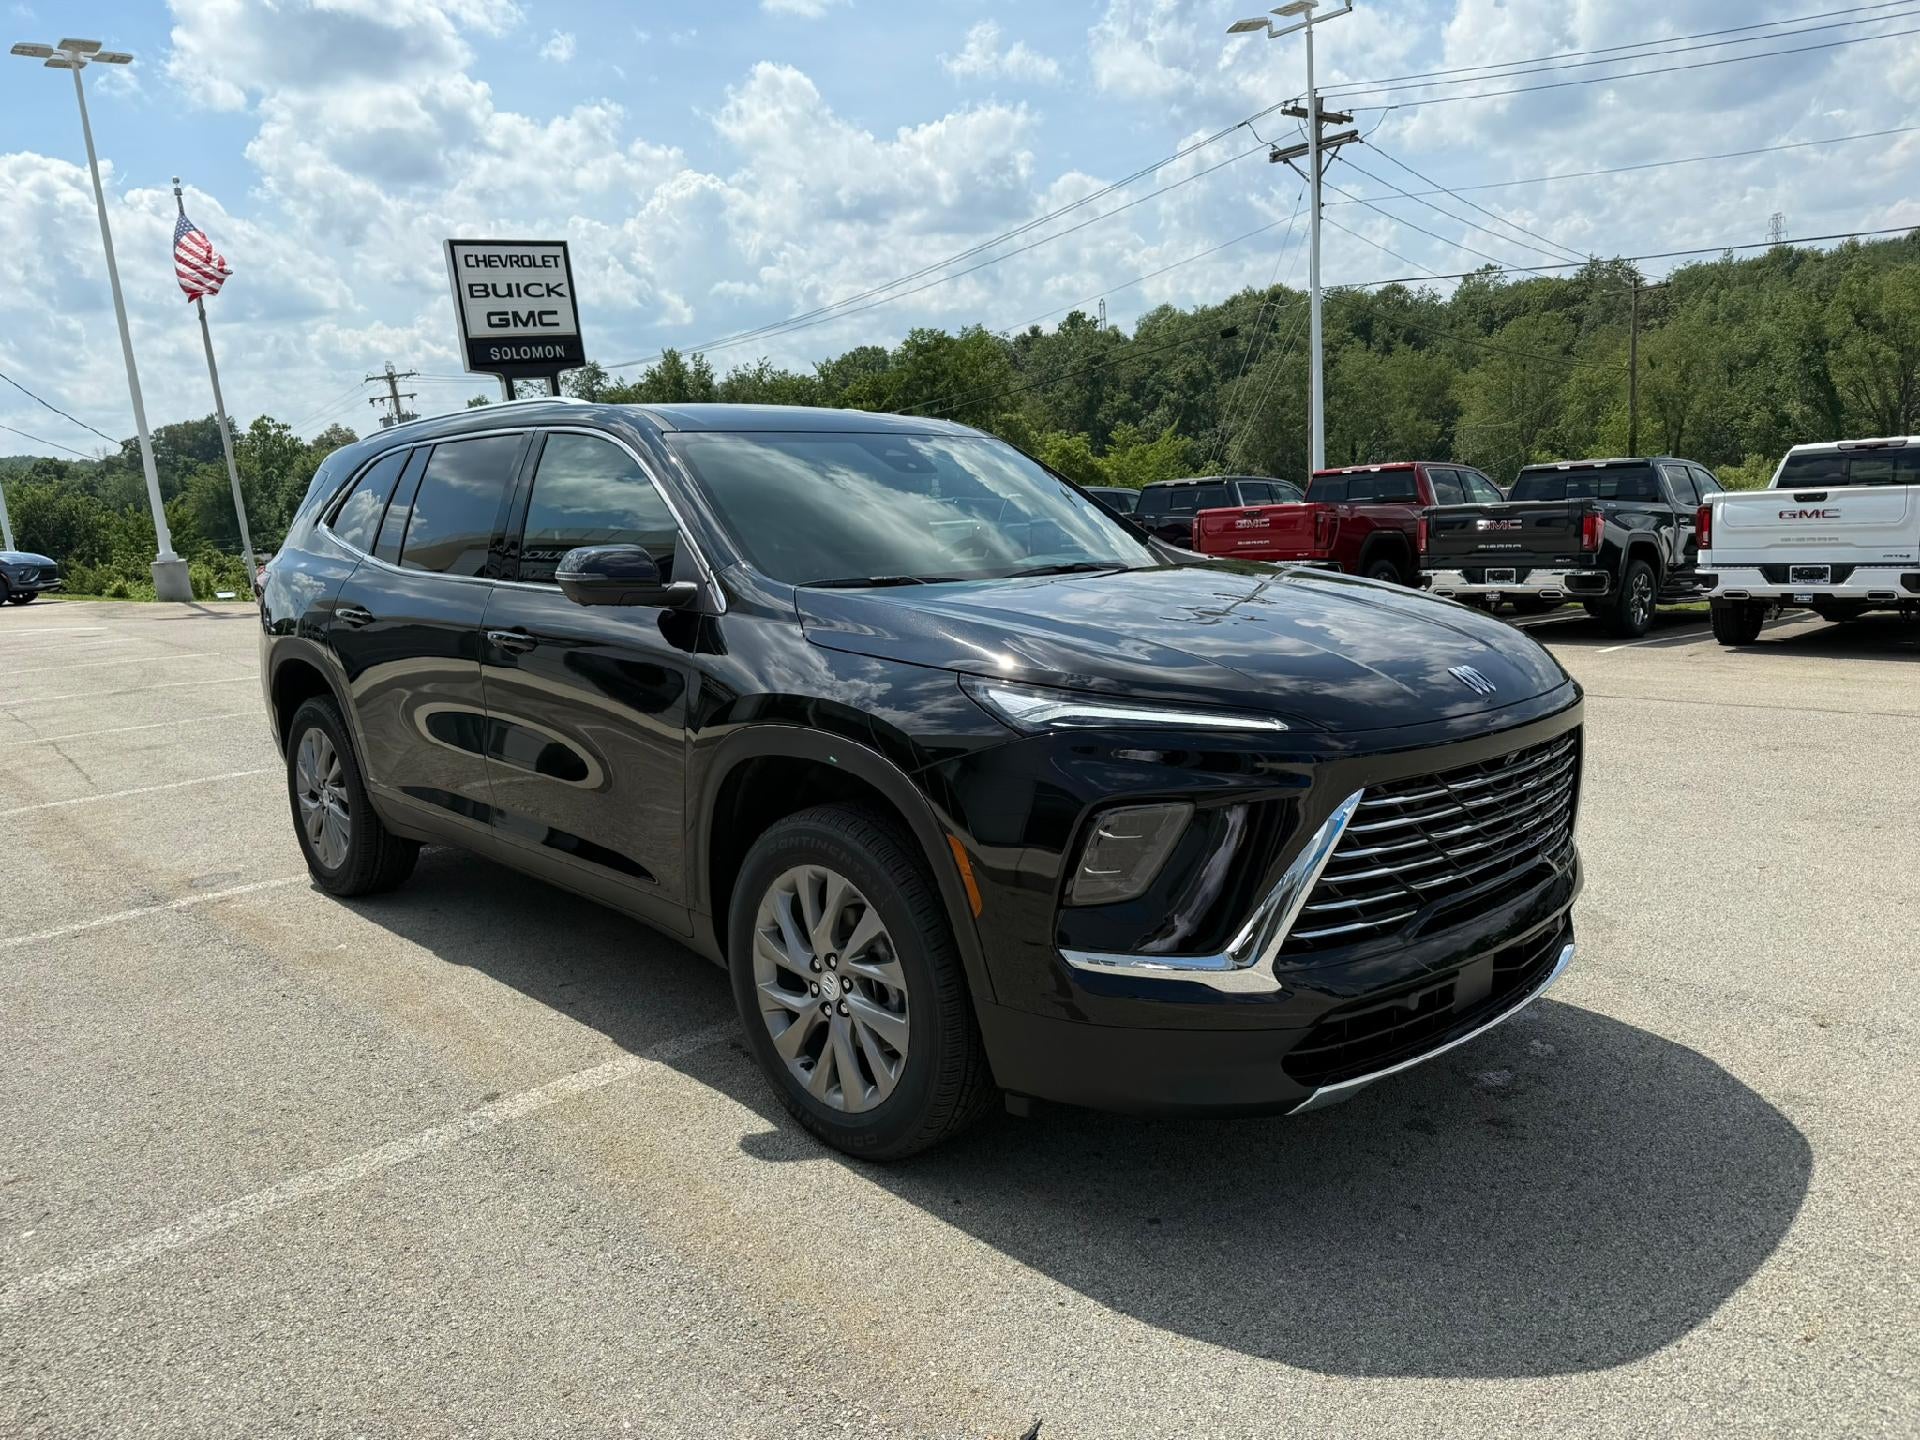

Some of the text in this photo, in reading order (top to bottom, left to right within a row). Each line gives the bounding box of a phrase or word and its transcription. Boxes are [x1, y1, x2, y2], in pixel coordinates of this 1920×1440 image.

[464, 254, 560, 268] CHEVROLET
[468, 283, 567, 298] BUICK
[486, 310, 560, 328] GMC
[490, 345, 565, 360] SOLOMON
[1779, 508, 1841, 519] GMC
[1235, 518, 1270, 529] GMC
[1477, 519, 1522, 530] GMC
